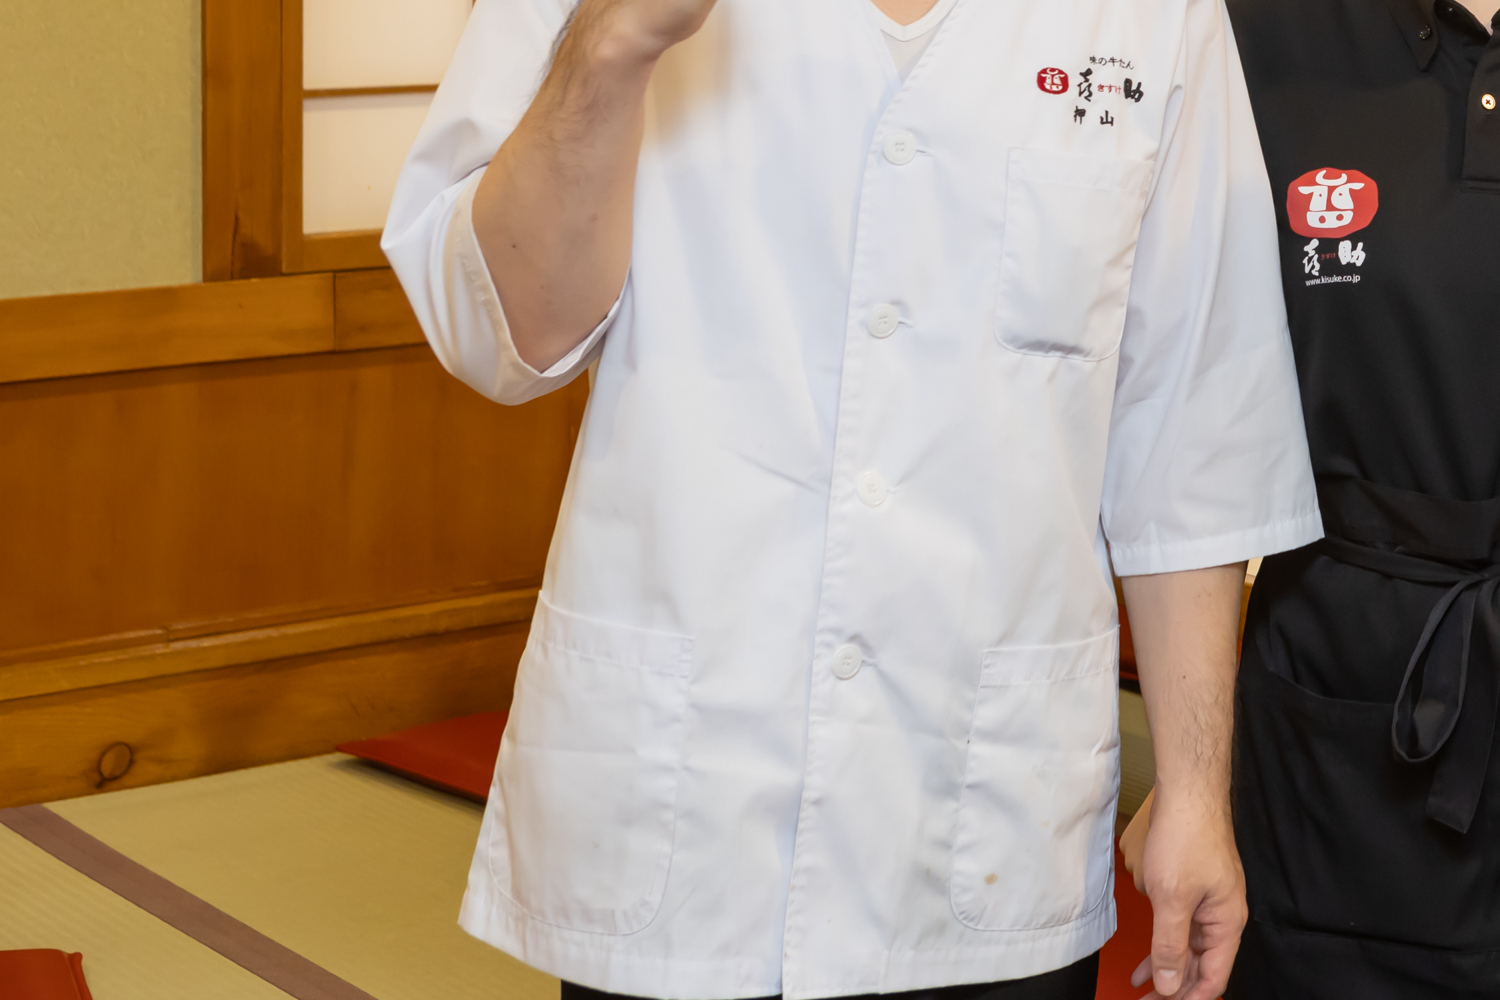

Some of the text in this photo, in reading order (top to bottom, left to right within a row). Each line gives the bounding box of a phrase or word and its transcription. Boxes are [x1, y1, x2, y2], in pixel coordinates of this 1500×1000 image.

[1089, 55, 1135, 70] 味の牛たん
[1305, 274, 1361, 287] www.kisuke.co.jp
